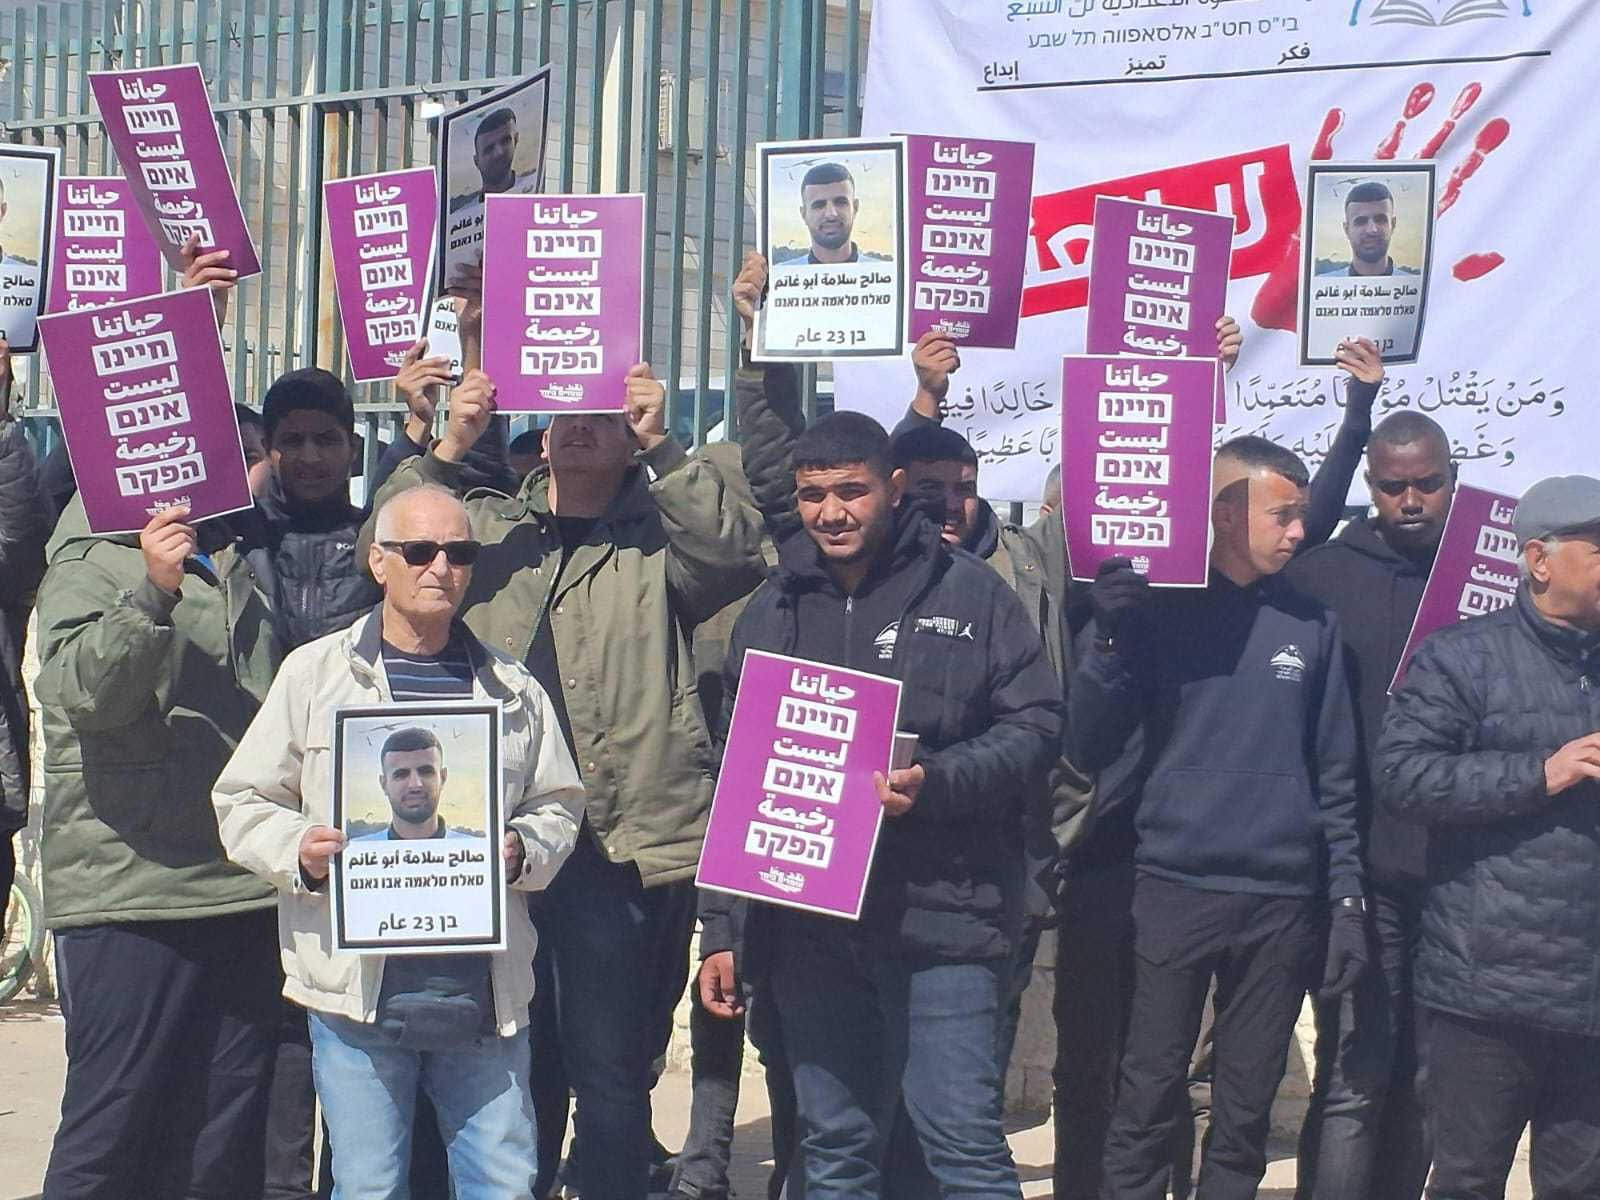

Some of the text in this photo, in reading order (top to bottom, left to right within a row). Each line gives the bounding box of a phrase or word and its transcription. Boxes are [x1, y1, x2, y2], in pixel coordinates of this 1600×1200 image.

[1027, 32, 1065, 48] שבע
[1073, 29, 1095, 46] תל
[1278, 42, 1311, 65] فكر
[983, 61, 1019, 84] إبداع
[118, 78, 167, 102] حياتنا
[128, 110, 175, 129] חיינו
[136, 134, 184, 160] ليست
[933, 142, 992, 169] حياتنا
[147, 167, 189, 185] אינם
[932, 174, 989, 194] חיינו
[67, 184, 119, 208] حياتنا
[153, 192, 203, 219] رخيصة
[355, 182, 401, 206] حياتنا
[68, 215, 119, 231] חיינו
[358, 210, 402, 231] חיינו
[533, 203, 598, 229] حياتنا
[926, 202, 991, 226] ليست
[1136, 210, 1193, 240] حياتنا
[66, 240, 123, 263] ليست
[360, 235, 407, 259] ليست
[533, 235, 596, 253] חיינו
[929, 230, 985, 250] אינם
[1134, 242, 1189, 267] חיינו
[3, 274, 35, 290] صالح
[73, 269, 120, 287] אינם
[366, 263, 407, 284] אינם
[529, 260, 598, 285] ليست
[920, 255, 989, 285] رخيصة
[1128, 274, 1190, 299] ليست
[365, 292, 415, 313] رخيصة
[534, 293, 594, 310] אינם
[920, 287, 985, 312] הפקר
[92, 310, 163, 338] حياتنا
[1132, 301, 1183, 324] אינם
[370, 319, 416, 342] הפקר
[525, 317, 600, 344] رخيصة
[795, 327, 866, 347] בן 23 عام
[99, 340, 170, 370] חיינו
[525, 351, 598, 374] הפקר
[104, 365, 180, 400] ليست
[1105, 364, 1168, 391] حياتنا
[116, 400, 183, 429] אינם
[1105, 398, 1166, 418] חיינו
[116, 432, 196, 460] رخيصة
[1099, 426, 1168, 452] ليست
[122, 460, 201, 492] הפקר
[1103, 458, 1162, 478] אינם
[1094, 485, 1168, 516] رخيصة
[1095, 521, 1164, 545] הפקר
[1483, 533, 1517, 552] יינו
[1471, 563, 1519, 593] يست
[1468, 591, 1512, 611] ינם
[790, 668, 856, 703] حياتنا
[785, 703, 849, 734] חיינו
[773, 736, 848, 767] ليست
[774, 766, 836, 796] אינם
[758, 792, 834, 836] رخيصة
[754, 828, 827, 860] הפקר
[348, 849, 485, 870] صالح سلامة أبو غانم
[381, 876, 402, 889] אבו
[378, 913, 458, 936] בן 23 عام
